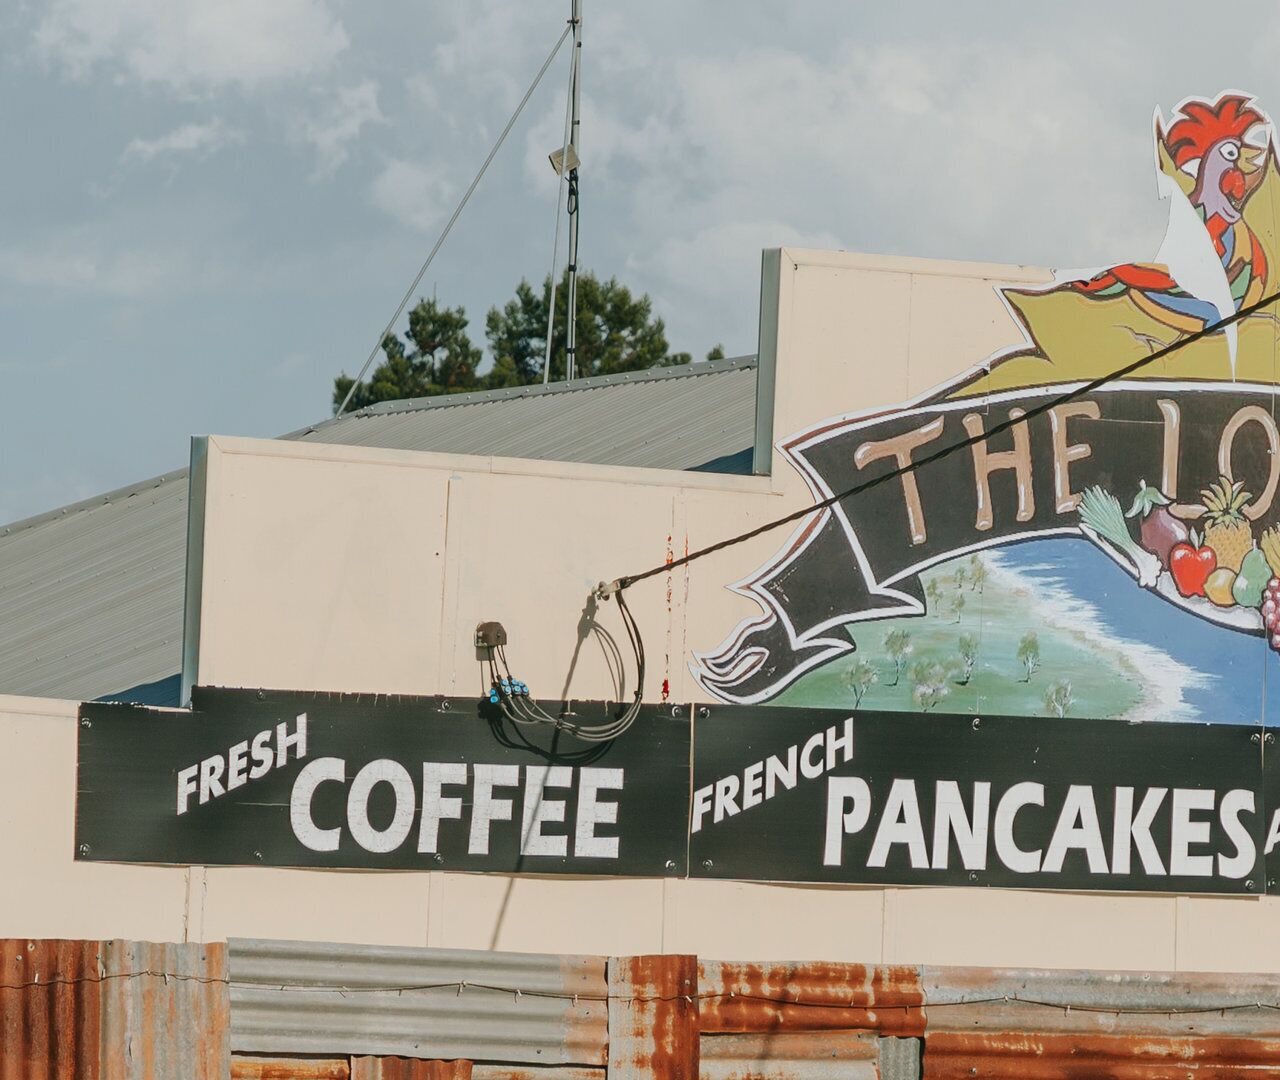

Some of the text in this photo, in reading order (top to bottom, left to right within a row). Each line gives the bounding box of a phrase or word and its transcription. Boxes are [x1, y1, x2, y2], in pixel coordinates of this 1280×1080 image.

[854, 399, 1101, 545] THE
[176, 713, 625, 859] FRESH COFFEE
[691, 717, 1257, 879] FRENCH PANCAKES
